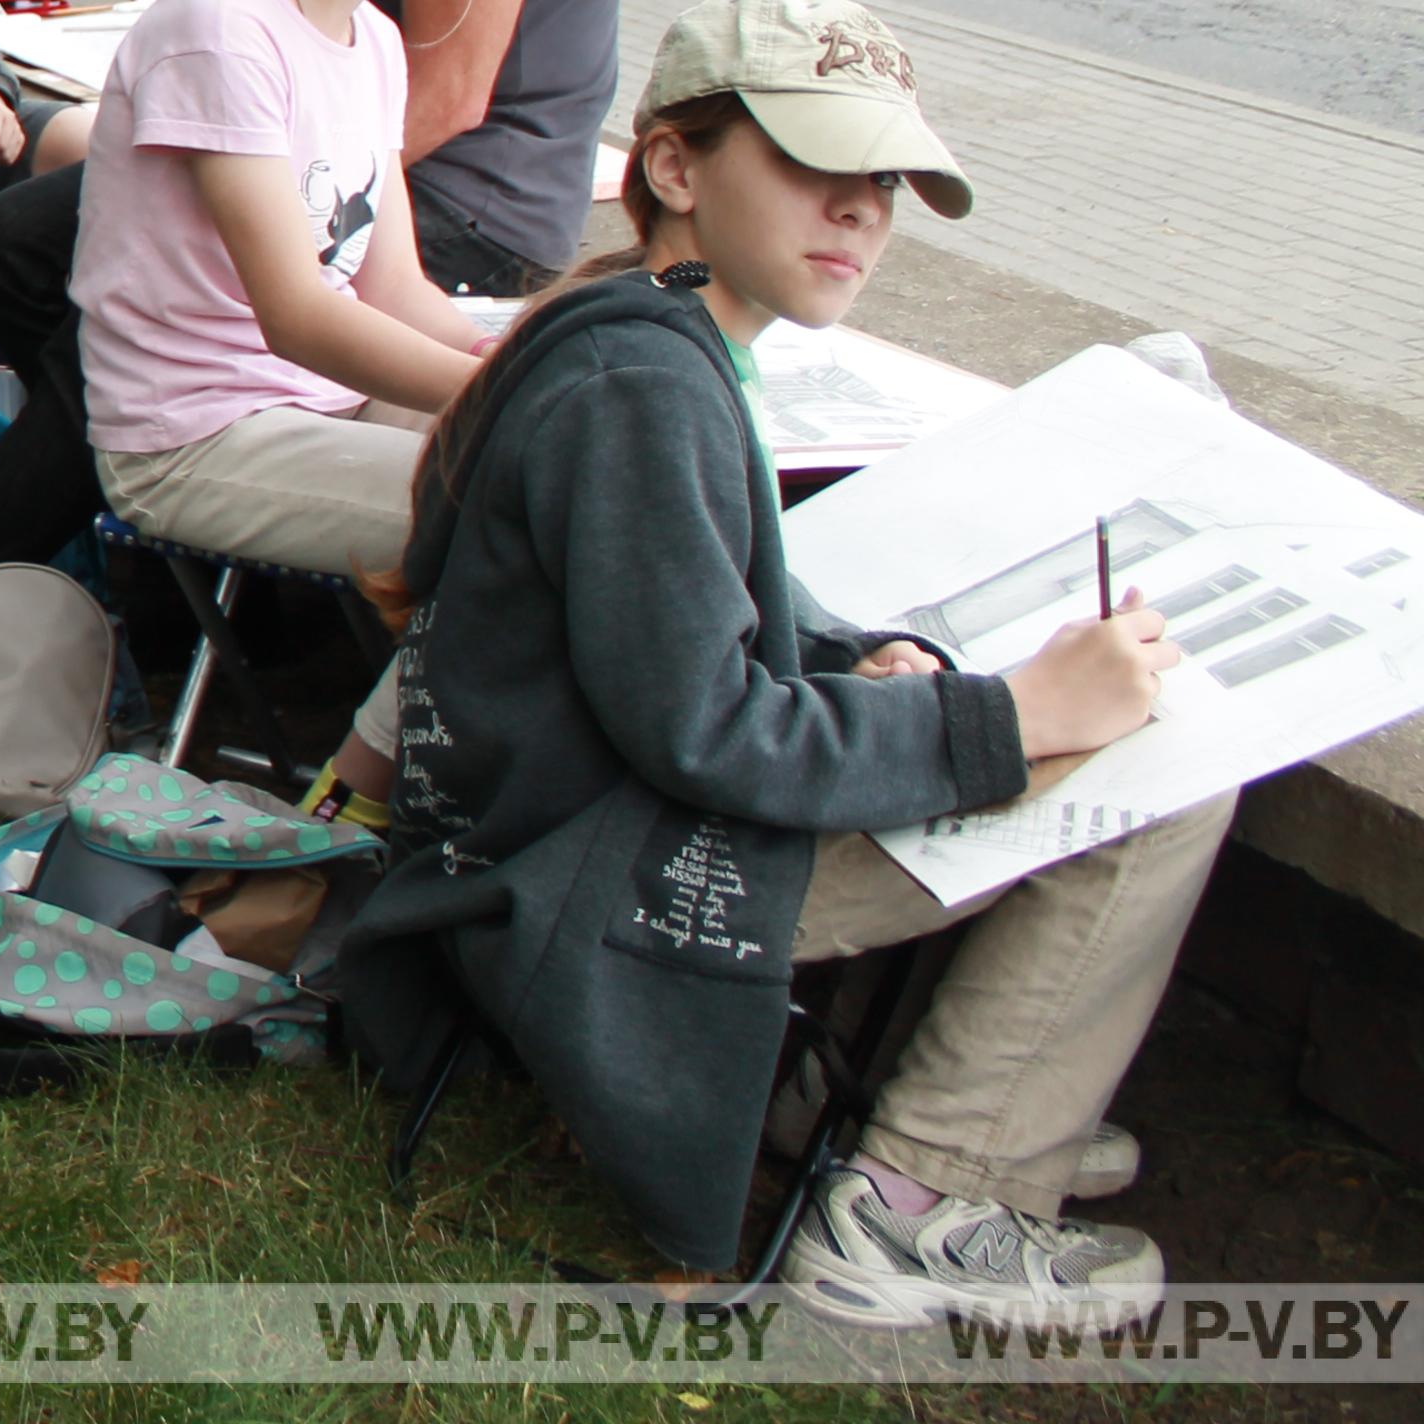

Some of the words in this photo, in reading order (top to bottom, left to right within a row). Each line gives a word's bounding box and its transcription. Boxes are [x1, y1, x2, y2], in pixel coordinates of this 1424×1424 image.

[633, 907, 646, 923] I
[698, 934, 731, 949] miss
[736, 940, 764, 960] you
[960, 1219, 1021, 1273] N
